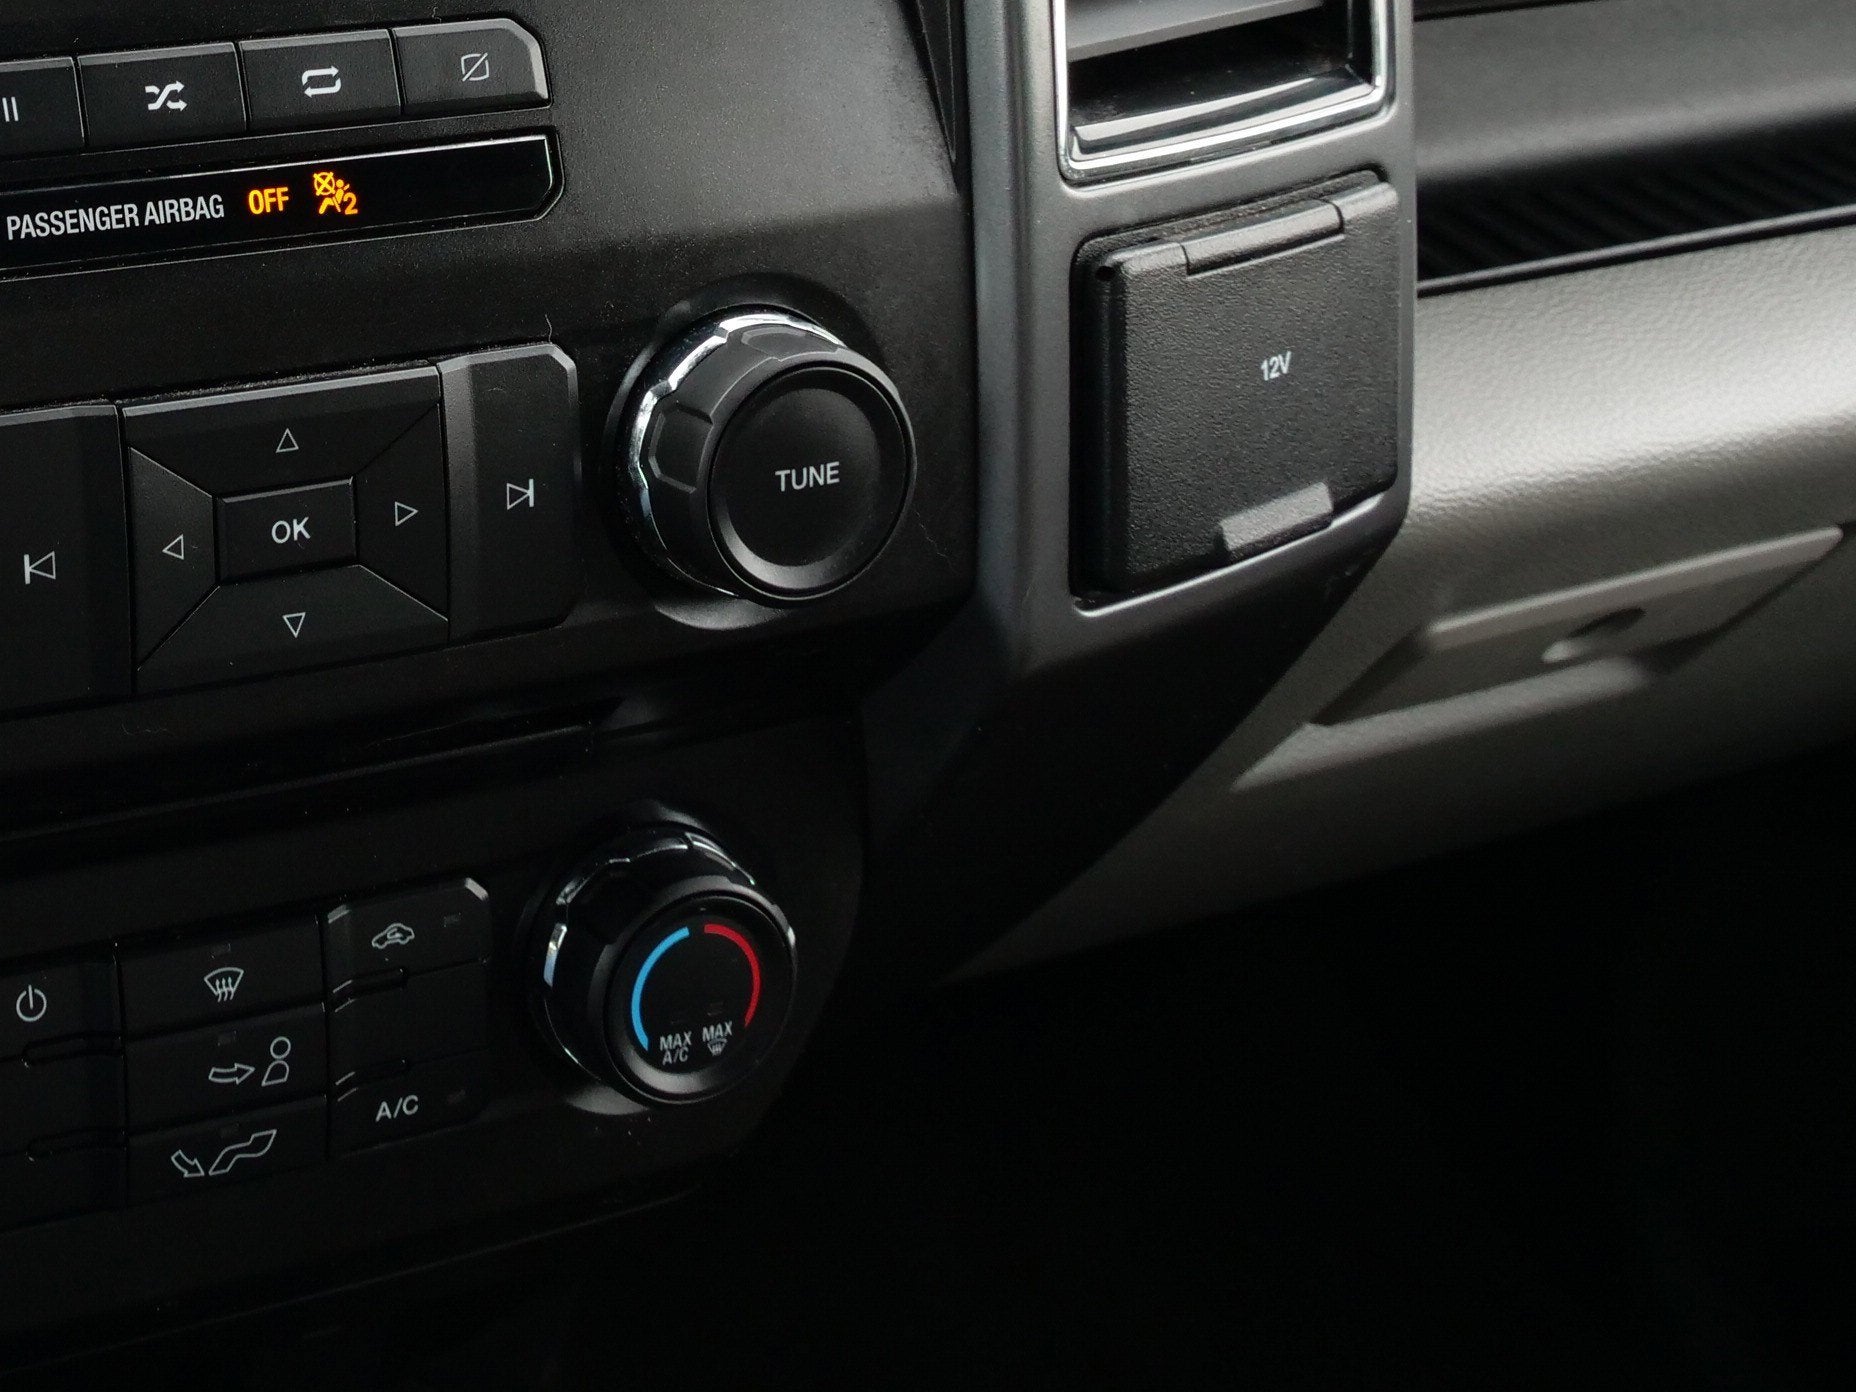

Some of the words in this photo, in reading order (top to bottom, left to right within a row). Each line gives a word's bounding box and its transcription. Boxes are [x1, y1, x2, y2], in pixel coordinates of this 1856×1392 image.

[6, 203, 140, 241] PASSENGER
[144, 194, 225, 226] AIRBAG
[247, 186, 290, 215] OFF
[1260, 350, 1292, 381] 12V
[774, 461, 840, 492] TUNE
[271, 516, 311, 544] OK
[659, 1030, 693, 1051] MAX
[701, 1020, 734, 1041] MAX
[662, 1046, 689, 1066] A/C
[375, 1094, 419, 1122] A/C
